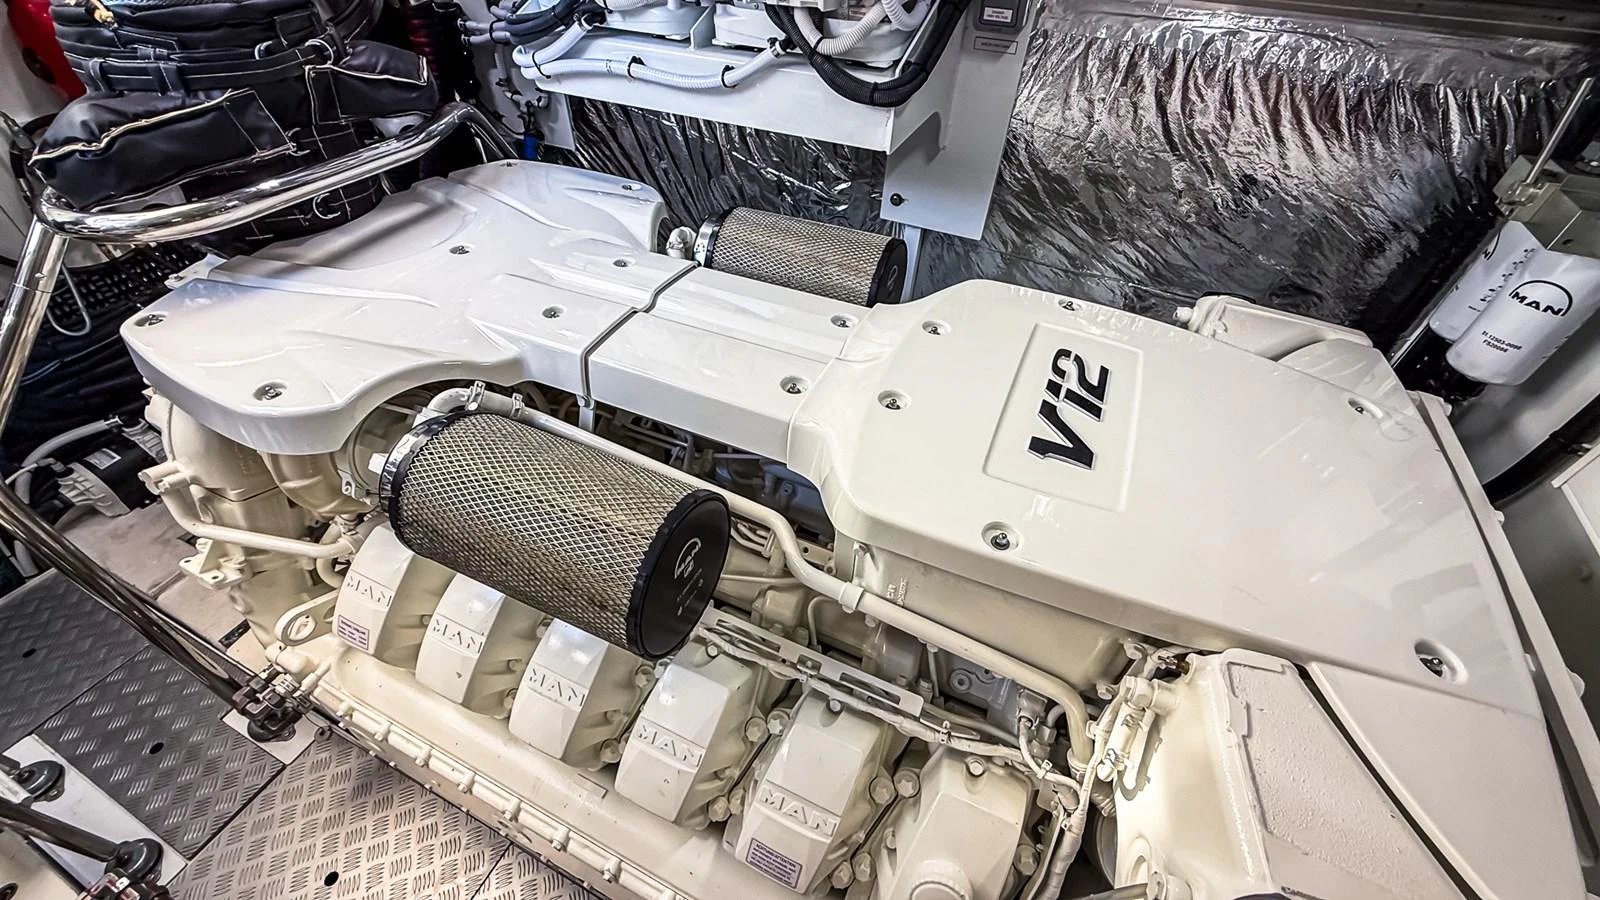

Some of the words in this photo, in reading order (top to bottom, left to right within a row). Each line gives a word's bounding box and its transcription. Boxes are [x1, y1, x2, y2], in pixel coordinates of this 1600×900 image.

[1511, 291, 1564, 316] MAN
[1027, 348, 1111, 470] V12
[347, 574, 393, 608] MAN
[432, 618, 484, 654] MAN
[528, 667, 586, 707] MAN
[637, 724, 702, 767] MAN
[760, 785, 837, 837] MAN
